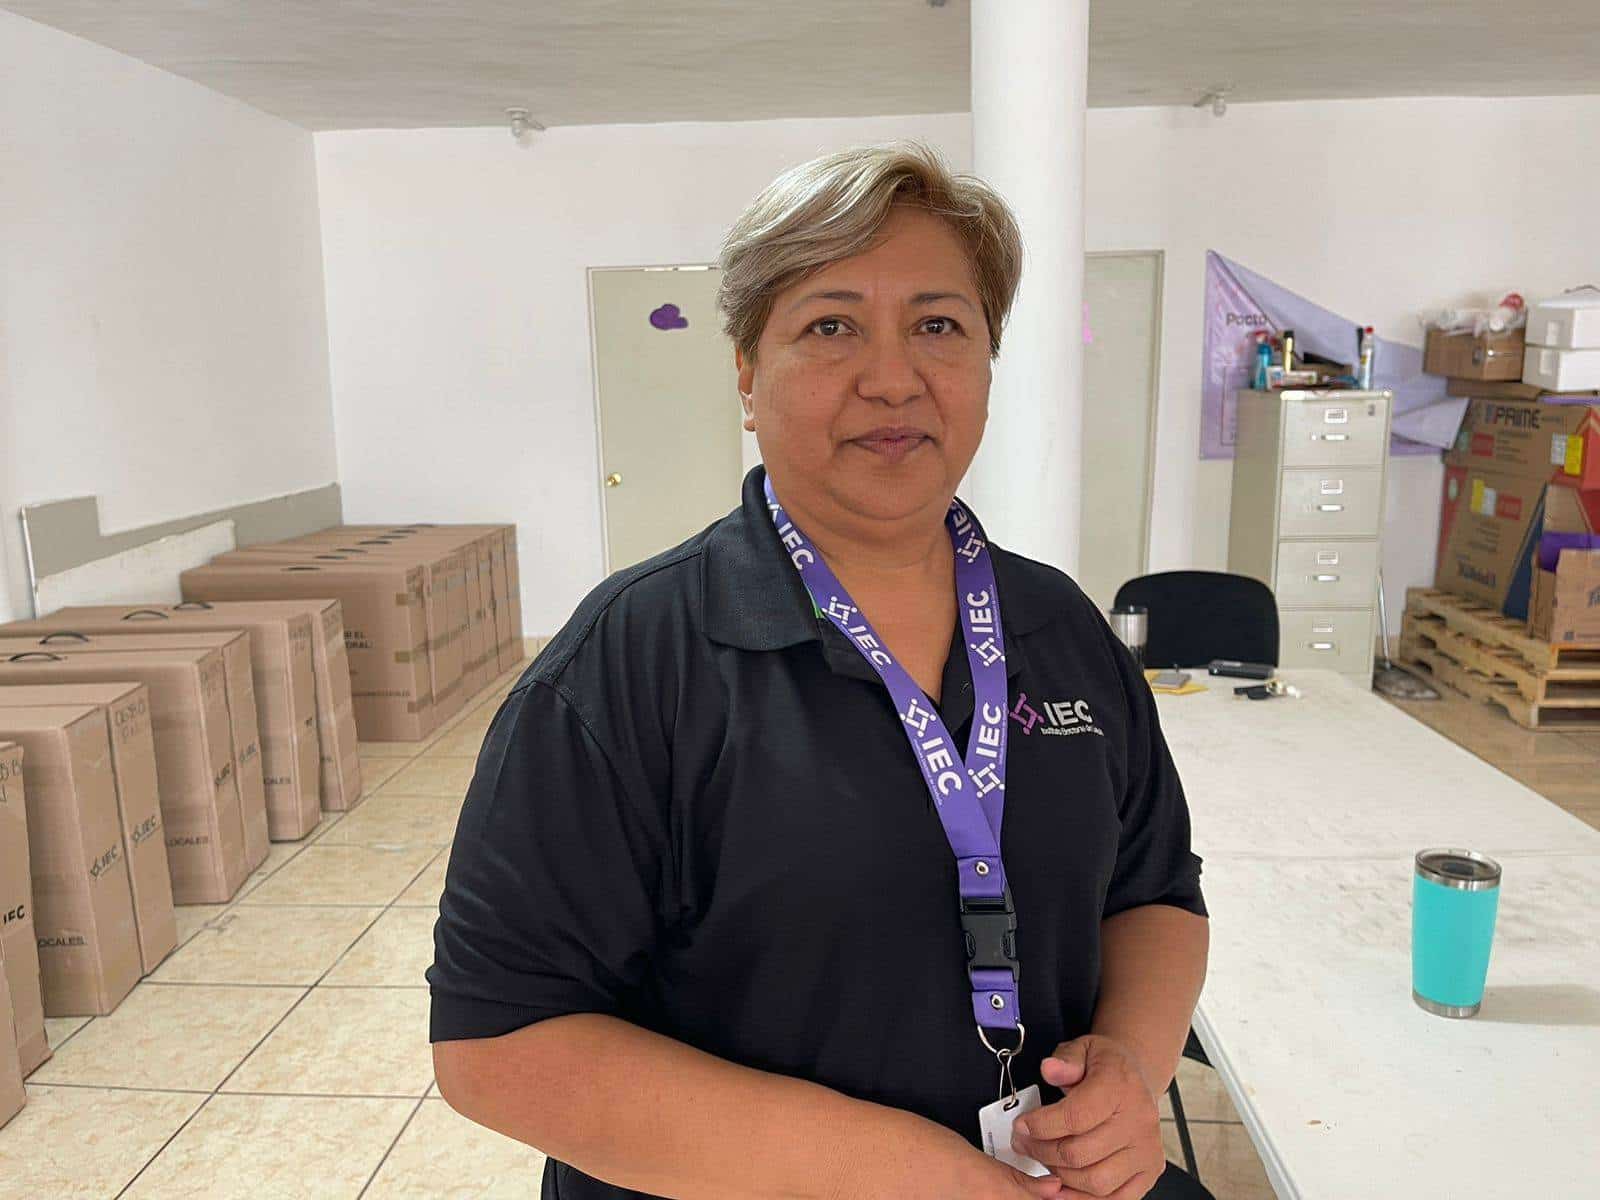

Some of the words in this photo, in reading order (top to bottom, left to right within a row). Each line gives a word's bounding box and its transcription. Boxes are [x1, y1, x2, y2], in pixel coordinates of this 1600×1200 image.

[778, 521, 815, 571] IEC
[967, 589, 994, 634] IEC
[849, 624, 892, 667] IEC
[975, 702, 1002, 759] IEC
[1043, 699, 1093, 726] IEC
[921, 736, 963, 796] IEC
